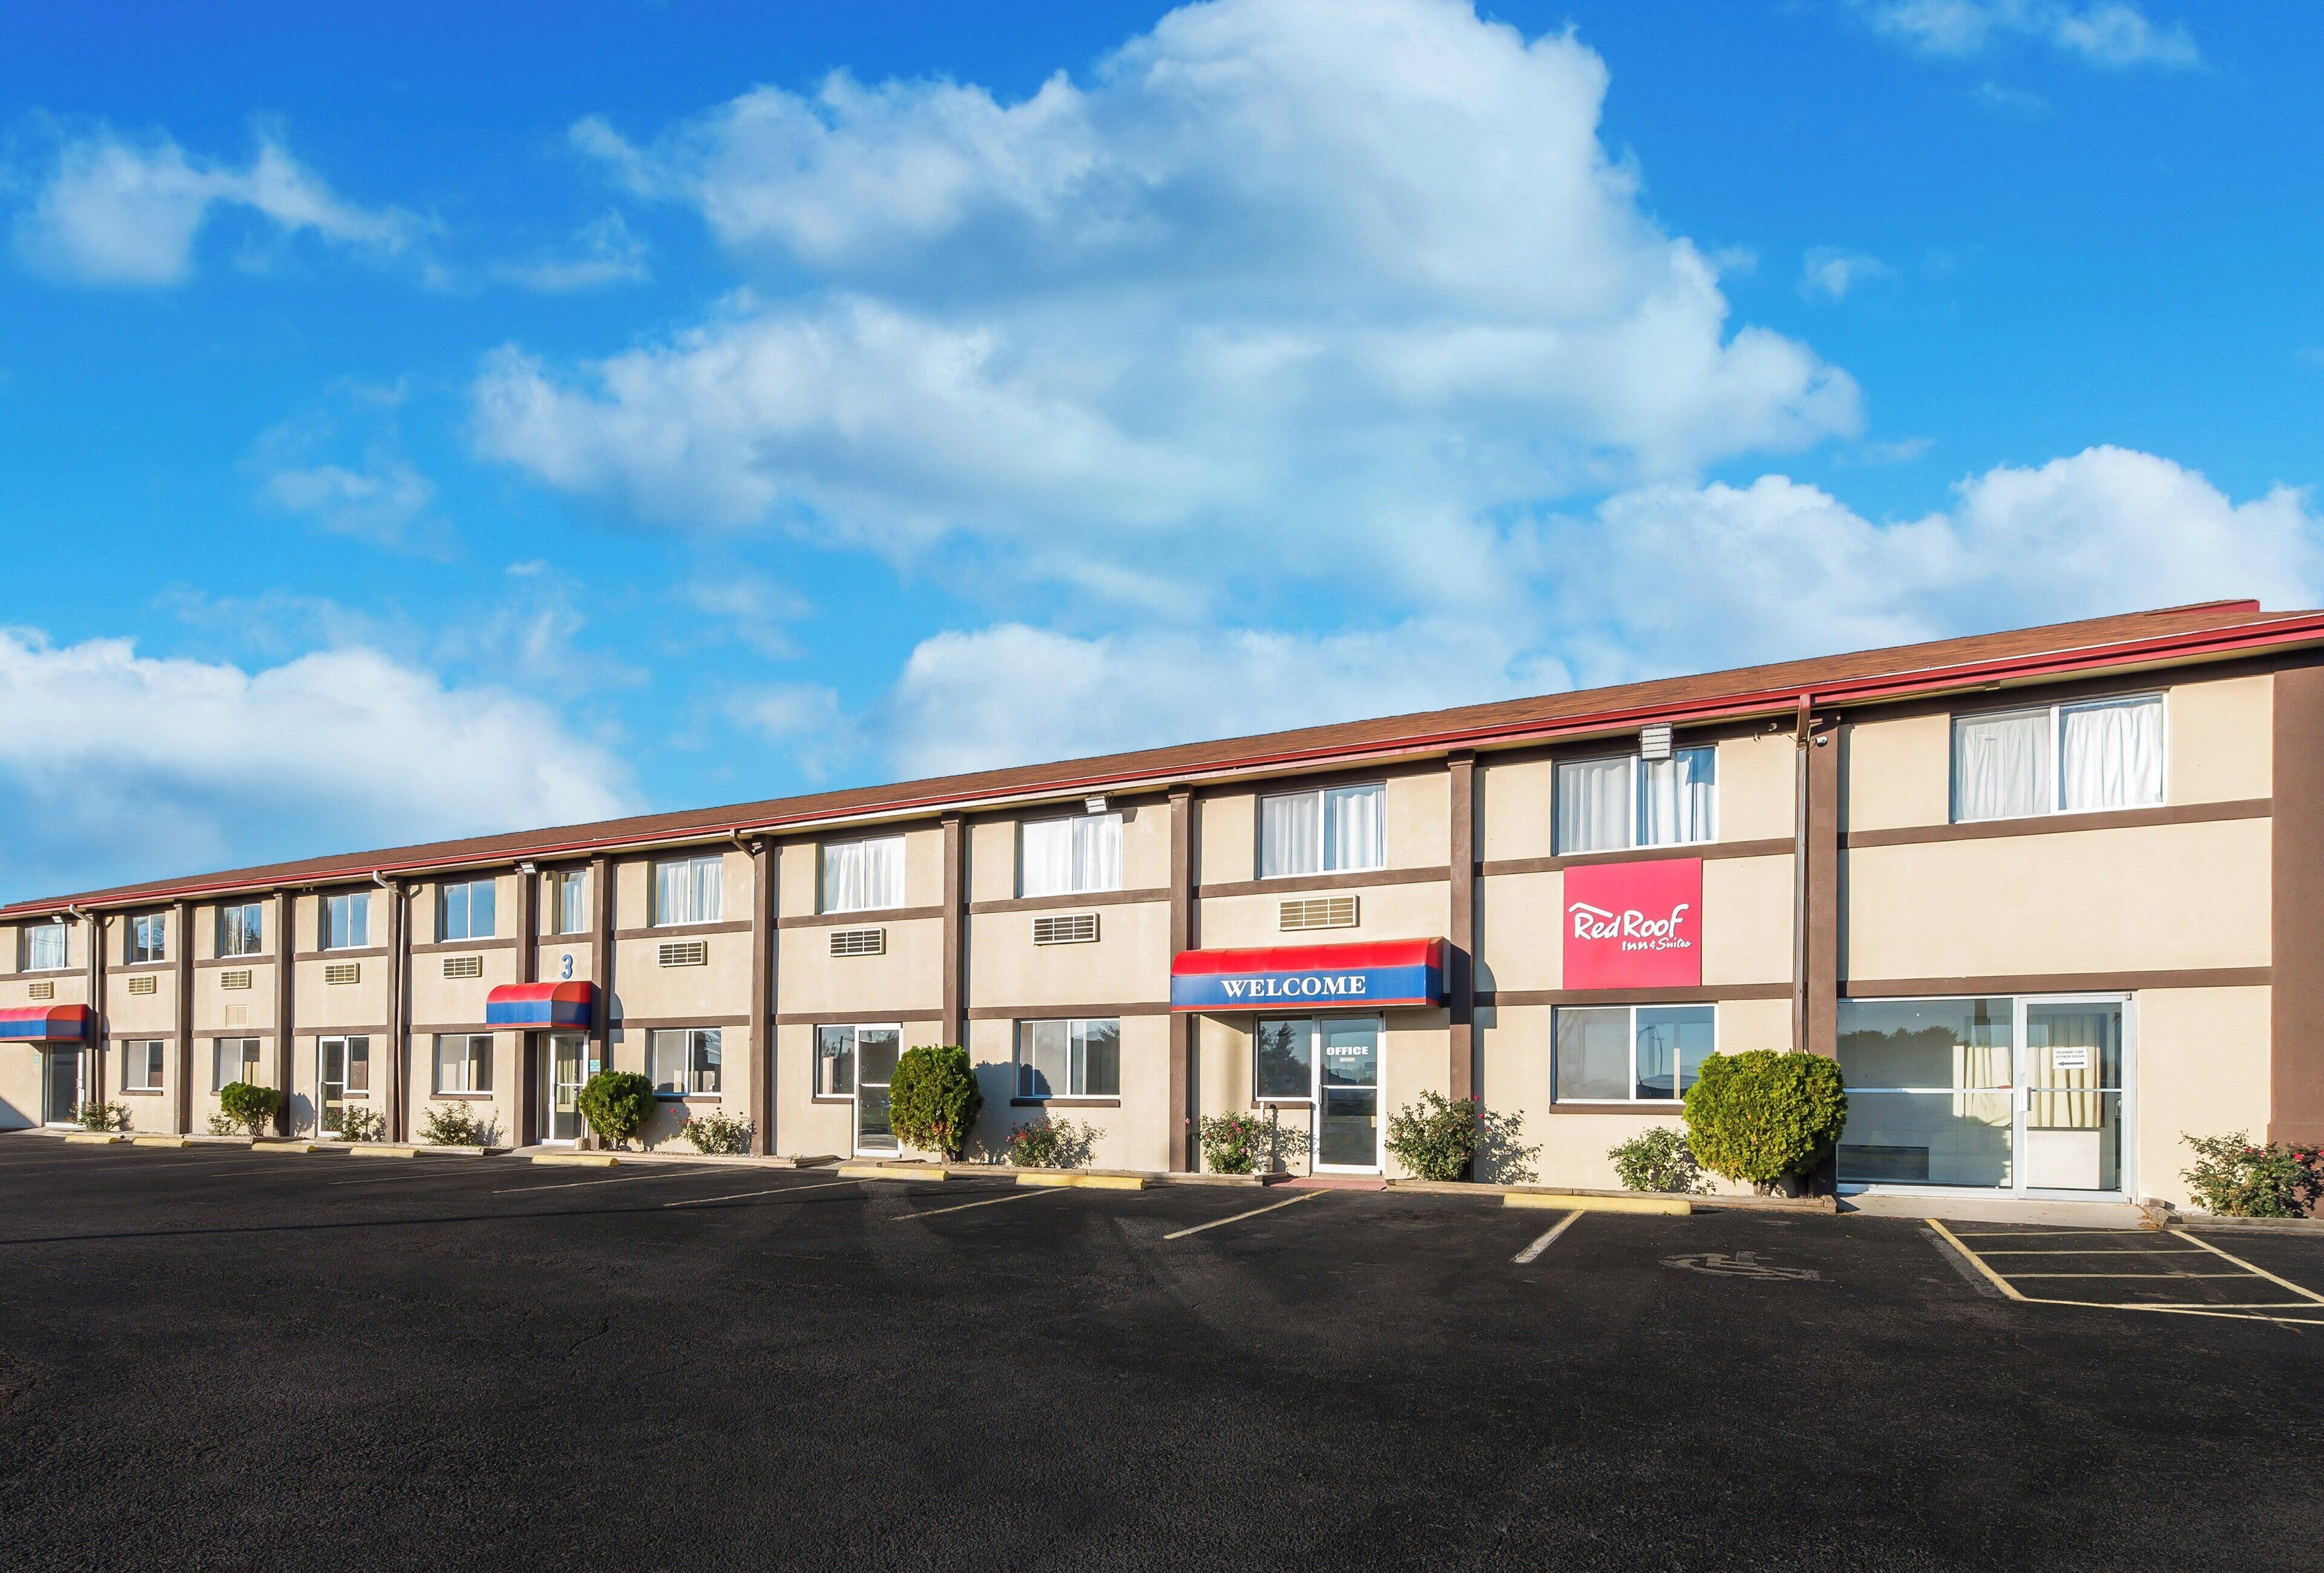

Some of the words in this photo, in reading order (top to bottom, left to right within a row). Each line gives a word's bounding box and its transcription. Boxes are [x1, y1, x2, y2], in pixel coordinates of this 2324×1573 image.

[1575, 912, 1621, 940] Red
[1623, 904, 1689, 938] Roof
[1649, 940, 1656, 950] &
[1656, 937, 1692, 951] Suites
[562, 954, 573, 979] 3
[1220, 976, 1366, 997] WELCOME
[1326, 1046, 1368, 1056] OFFICE
